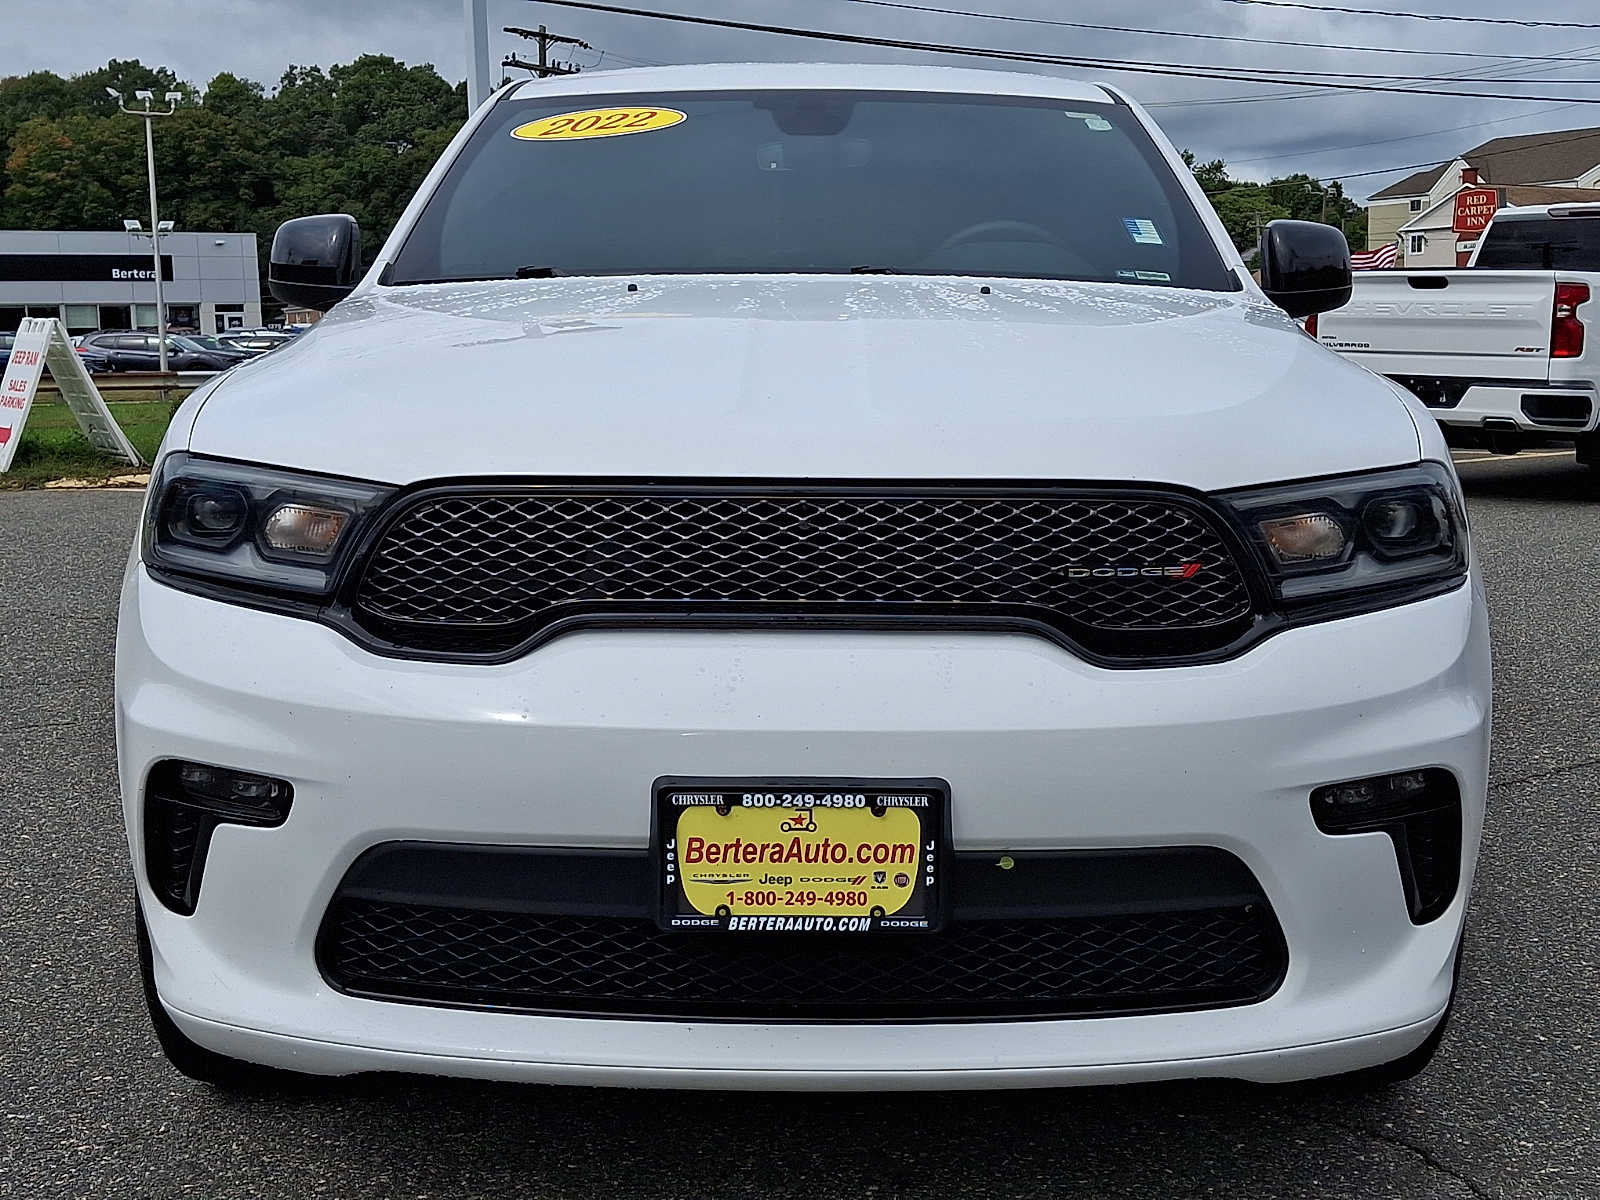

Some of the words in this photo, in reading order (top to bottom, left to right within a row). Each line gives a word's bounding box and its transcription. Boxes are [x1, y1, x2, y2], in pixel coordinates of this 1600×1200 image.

[539, 111, 657, 136] 2022
[1467, 194, 1487, 205] RED
[1458, 205, 1496, 216] CARPET
[1467, 216, 1486, 226] INN
[112, 268, 157, 279] Bertera
[12, 350, 26, 364] JEEP
[26, 351, 39, 365] RAM
[8, 379, 27, 392] SALES
[0, 395, 26, 409] PARKING
[1068, 567, 1185, 578] DODGE
[672, 794, 724, 805] CHRYSLER
[742, 794, 866, 808] 800-249-4980
[876, 795, 929, 807] CHRYSLER
[685, 837, 916, 865] BerteraAuto.com
[666, 839, 675, 885] Jeep
[926, 840, 935, 886] Jeep
[759, 873, 793, 886] Jeep
[726, 891, 868, 907] 1-800-249-4980
[728, 917, 871, 931] BERTERAAUTO.COM
[880, 920, 929, 928] DODGE
